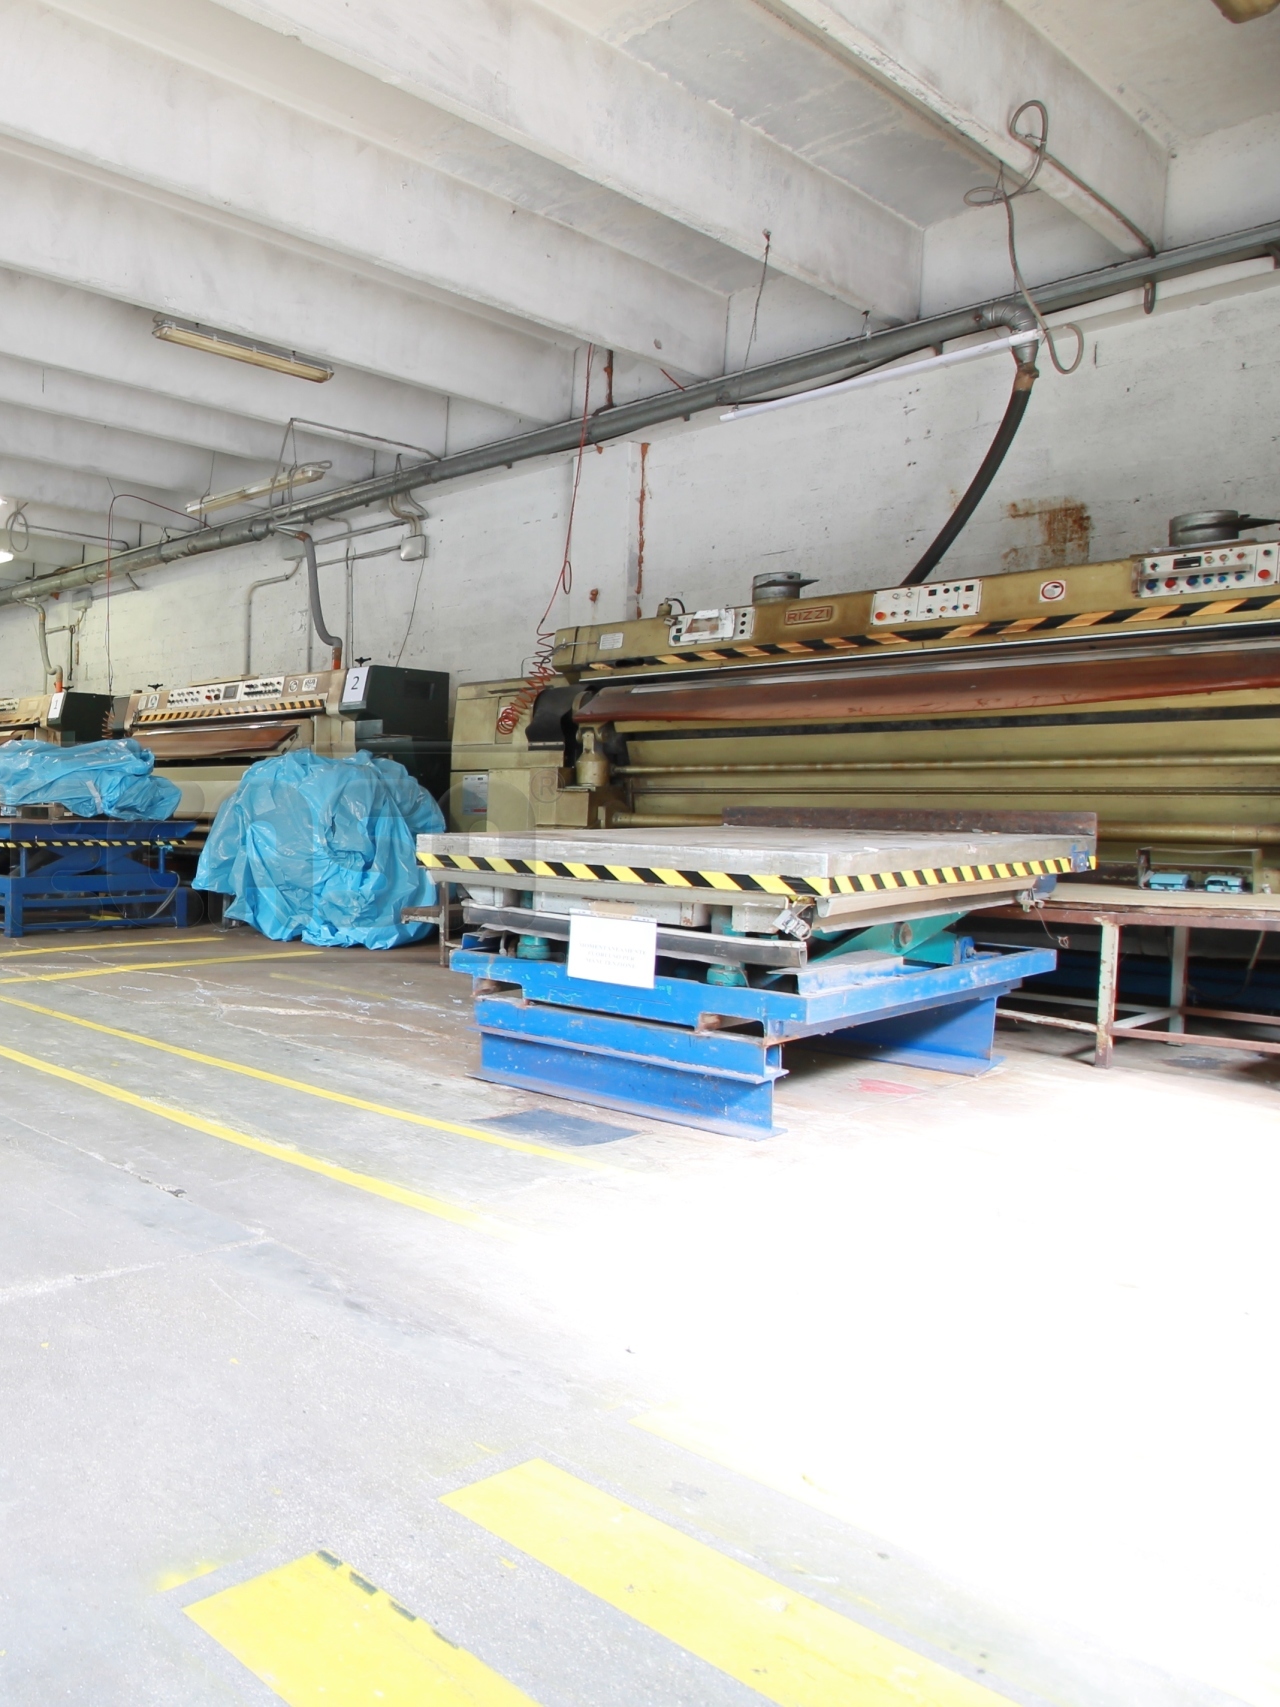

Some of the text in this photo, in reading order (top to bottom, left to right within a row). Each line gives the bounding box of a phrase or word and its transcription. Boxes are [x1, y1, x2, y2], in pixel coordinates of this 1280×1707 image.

[786, 609, 831, 622] RIZZI
[350, 675, 360, 690] 2
[53, 699, 59, 710] 1
[622, 954, 636, 962] PER
